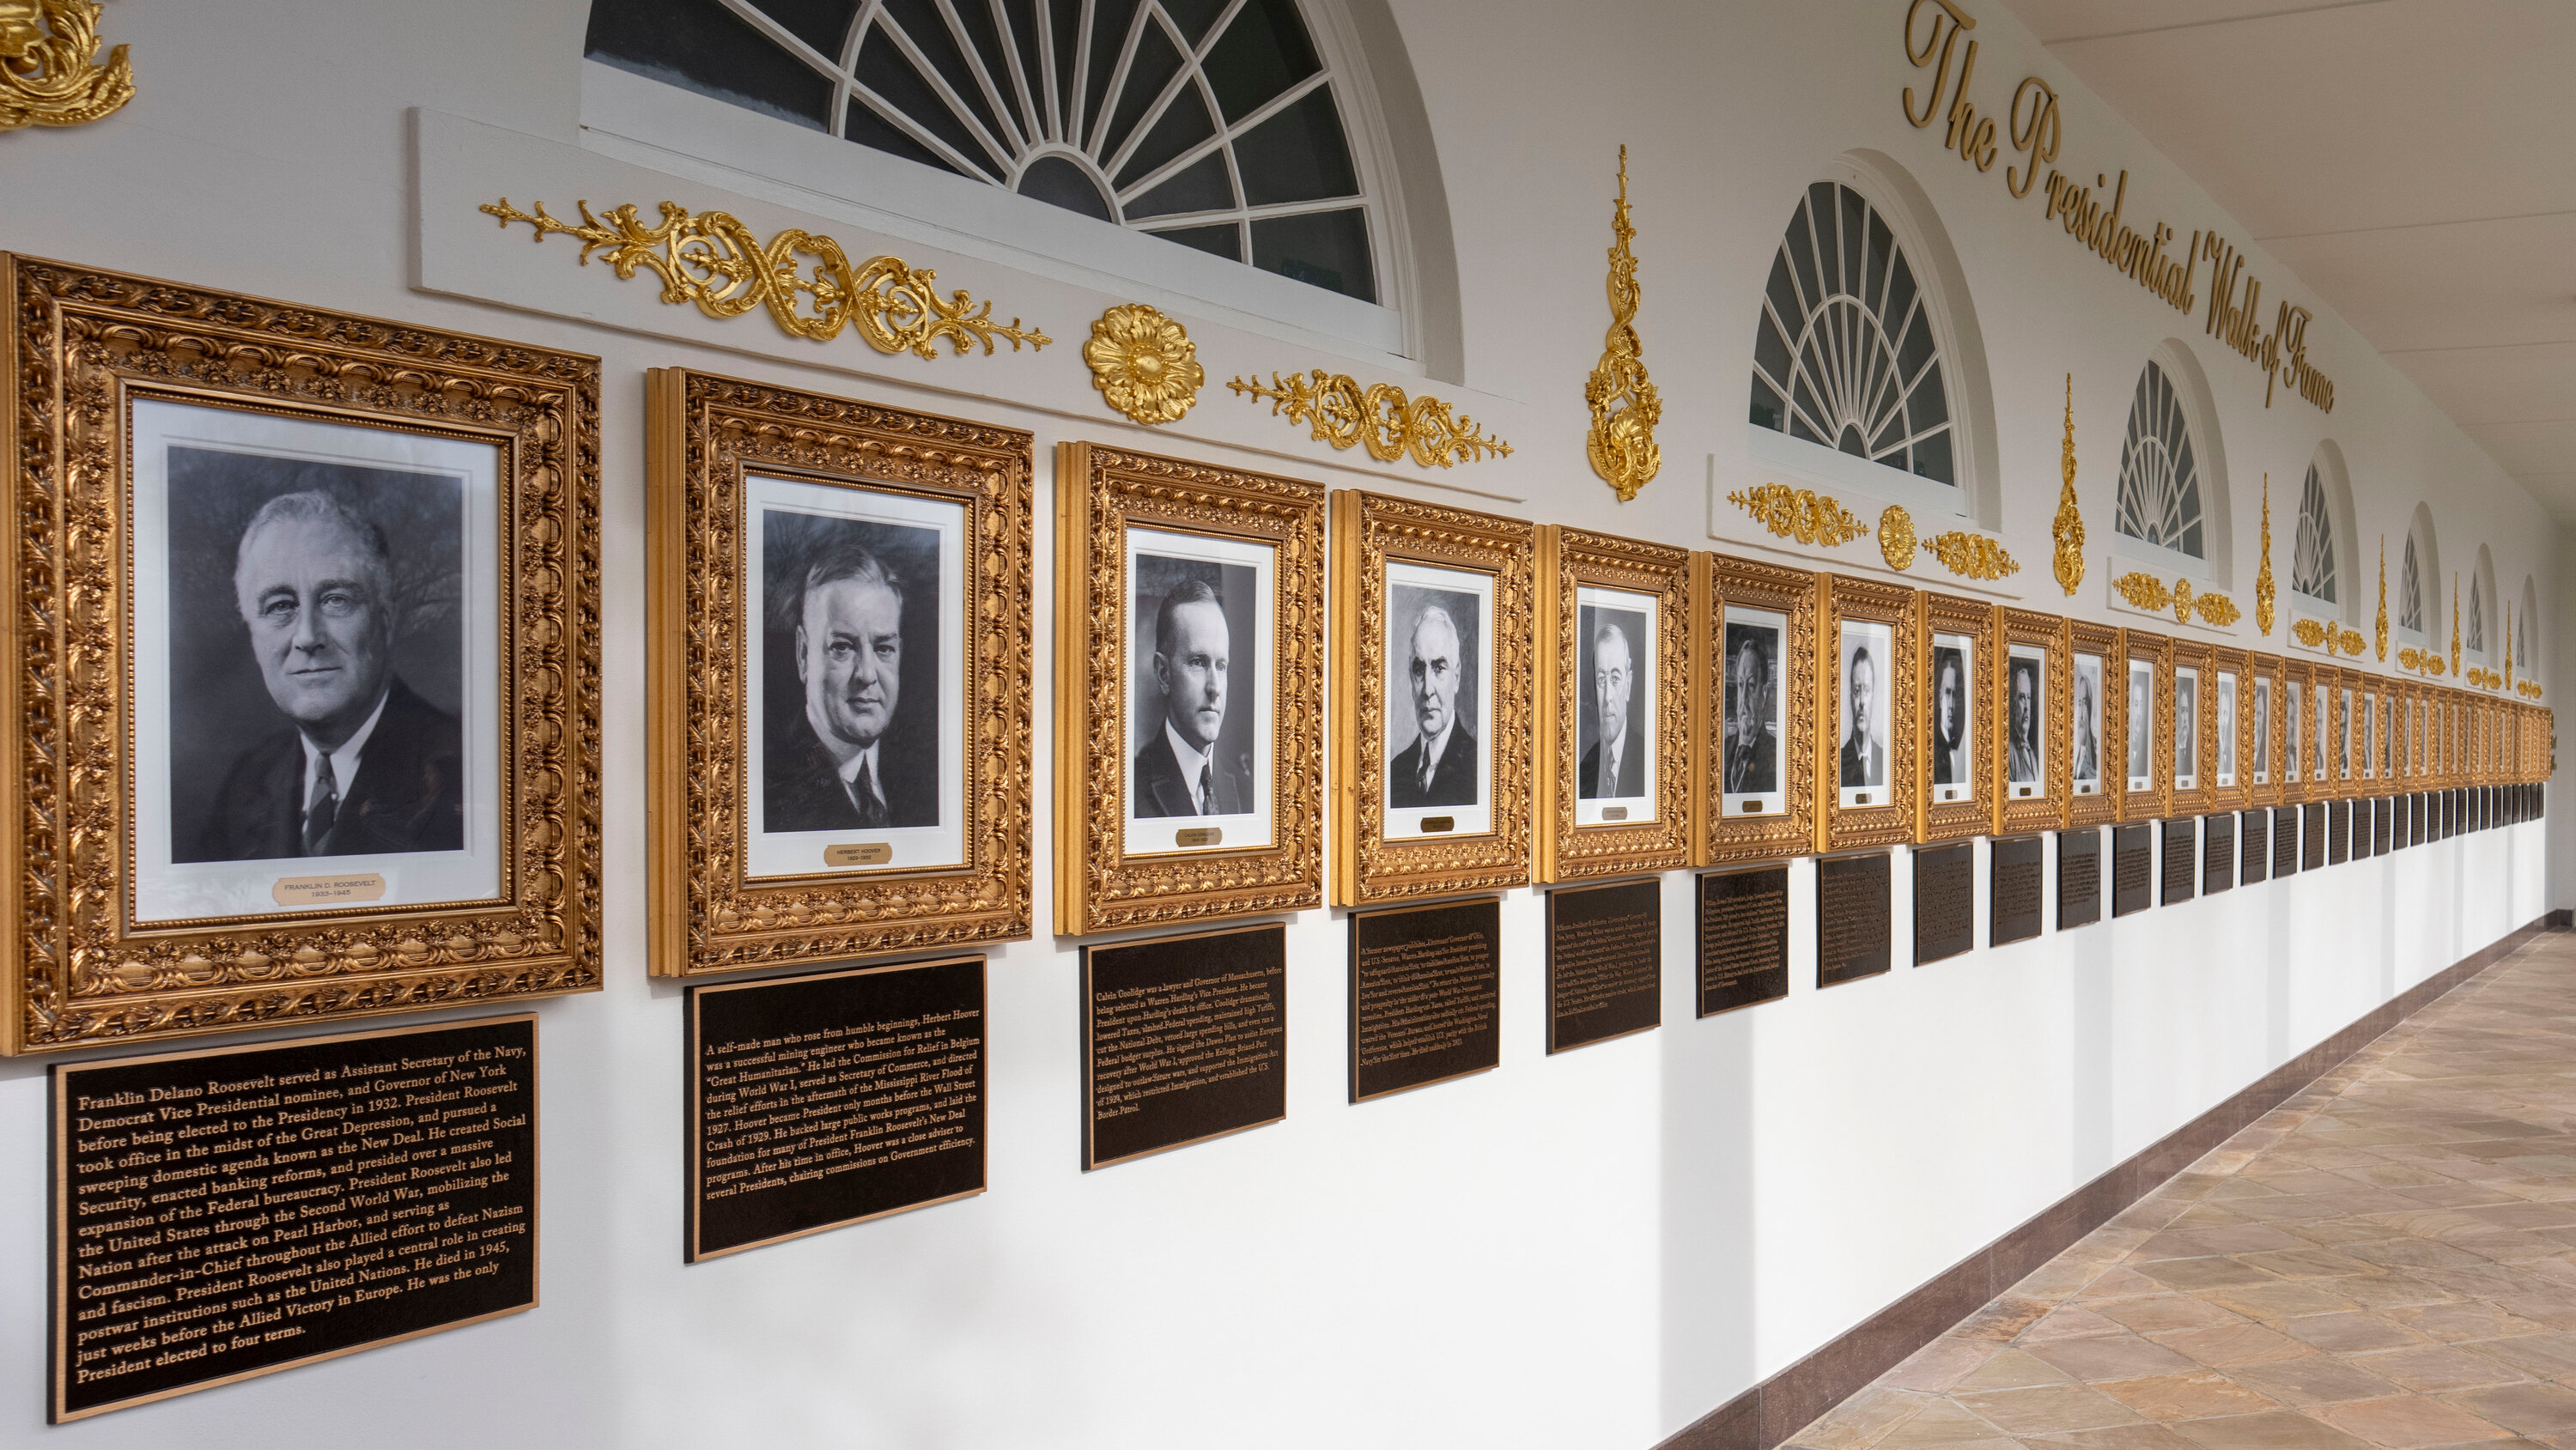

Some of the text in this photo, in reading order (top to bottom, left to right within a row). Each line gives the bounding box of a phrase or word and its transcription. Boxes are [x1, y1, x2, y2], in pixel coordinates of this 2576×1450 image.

[1902, 0, 2335, 414] The Presidential Walk of Fame
[284, 882, 323, 891] FRANKLIN
[333, 880, 376, 889] ROOSEVELT
[312, 889, 351, 898] 1933-1945
[706, 1063, 722, 1071] was
[733, 1052, 775, 1067] successful
[778, 1049, 808, 1061] mining
[810, 1045, 845, 1058] engineer
[848, 1040, 864, 1051] who
[866, 1038, 894, 1047] became
[896, 1034, 921, 1043] known
[933, 1028, 945, 1038] the
[717, 1040, 760, 1053] self-made
[762, 1039, 781, 1047] man
[783, 1034, 801, 1045] who
[823, 1029, 842, 1039] from
[845, 1023, 874, 1036] humble
[877, 1019, 920, 1033] beginnings,
[922, 1014, 951, 1025] Herbert
[953, 1011, 979, 1021] Hoover
[77, 1064, 506, 1131] Democrat Vice Presidential nominee, and Governor of New York
[78, 1047, 526, 1111] Franklin Delano Roosevelt served as Assistant Secretary of the Navy,
[706, 1108, 720, 1119] the
[724, 1103, 748, 1116] relief
[750, 1101, 777, 1112] efforts
[791, 1095, 804, 1105] the
[807, 1087, 846, 1102] aftermath
[860, 1083, 872, 1094] the
[874, 1075, 917, 1091] Mississippi
[920, 1073, 939, 1083] River
[941, 1068, 962, 1080] Flood
[707, 1091, 736, 1103] during
[738, 1084, 766, 1098] World
[769, 1083, 787, 1093] War
[799, 1075, 825, 1089] served
[839, 1071, 875, 1082] Secretary
[888, 1062, 930, 1074] Commerce,
[933, 1056, 945, 1067] and
[948, 1052, 976, 1065] directed
[77, 1081, 517, 1153] before being elected to the Presidency in 1932. President Roosevelt
[707, 1081, 975, 1135] 1927. Hoover became President only months before the Wall Street
[76, 1156, 113, 1174] took
[118, 1152, 161, 1168] office
[166, 1148, 180, 1161] in
[185, 1144, 208, 1157] the
[213, 1138, 252, 1154] midst
[257, 1133, 272, 1147] of
[276, 1131, 296, 1144] the
[301, 1125, 337, 1140] Great
[342, 1115, 413, 1135] Depression,
[418, 1109, 439, 1123] and
[443, 1102, 486, 1123] pursued
[78, 1114, 526, 1195] sweeping domestic agenda known as the New Deal. He created Social
[78, 1195, 146, 1216] Security,
[151, 1183, 206, 1204] enacted
[211, 1176, 267, 1194] banking
[271, 1168, 325, 1184] reforms,
[331, 1160, 352, 1174] and
[357, 1150, 408, 1174] presided
[411, 1150, 436, 1161] over
[450, 1139, 493, 1155] massive
